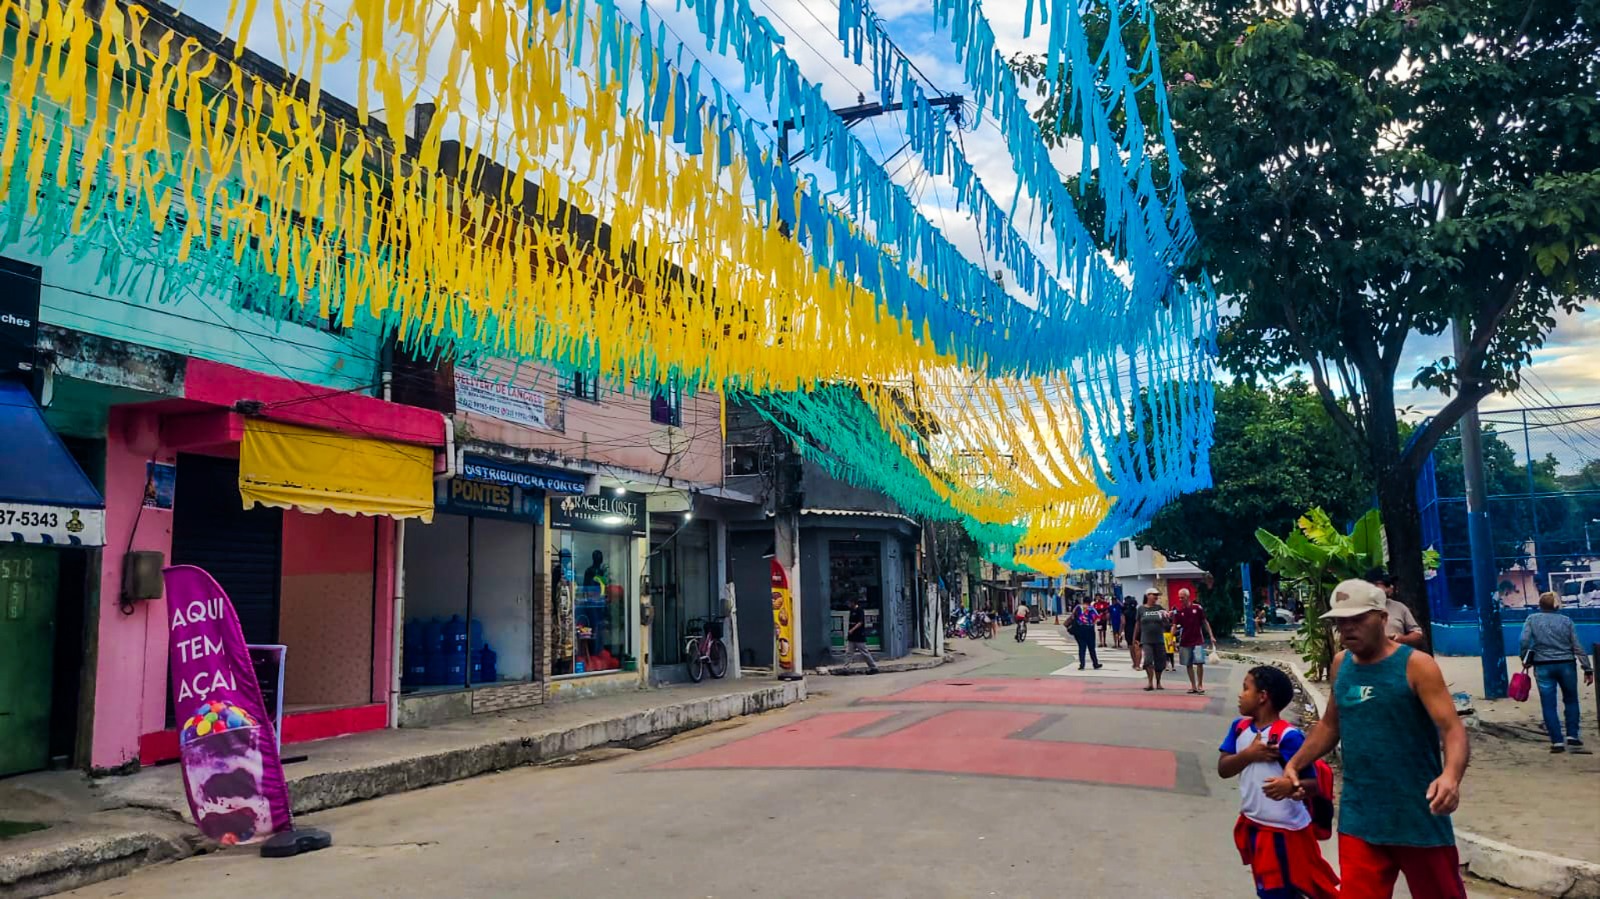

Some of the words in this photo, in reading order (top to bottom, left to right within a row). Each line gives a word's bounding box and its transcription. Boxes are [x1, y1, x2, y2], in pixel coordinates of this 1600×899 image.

[452, 479, 511, 506] PONTES
[547, 479, 586, 494] PONTES
[171, 597, 225, 631] AQUI
[177, 634, 225, 664] TEM
